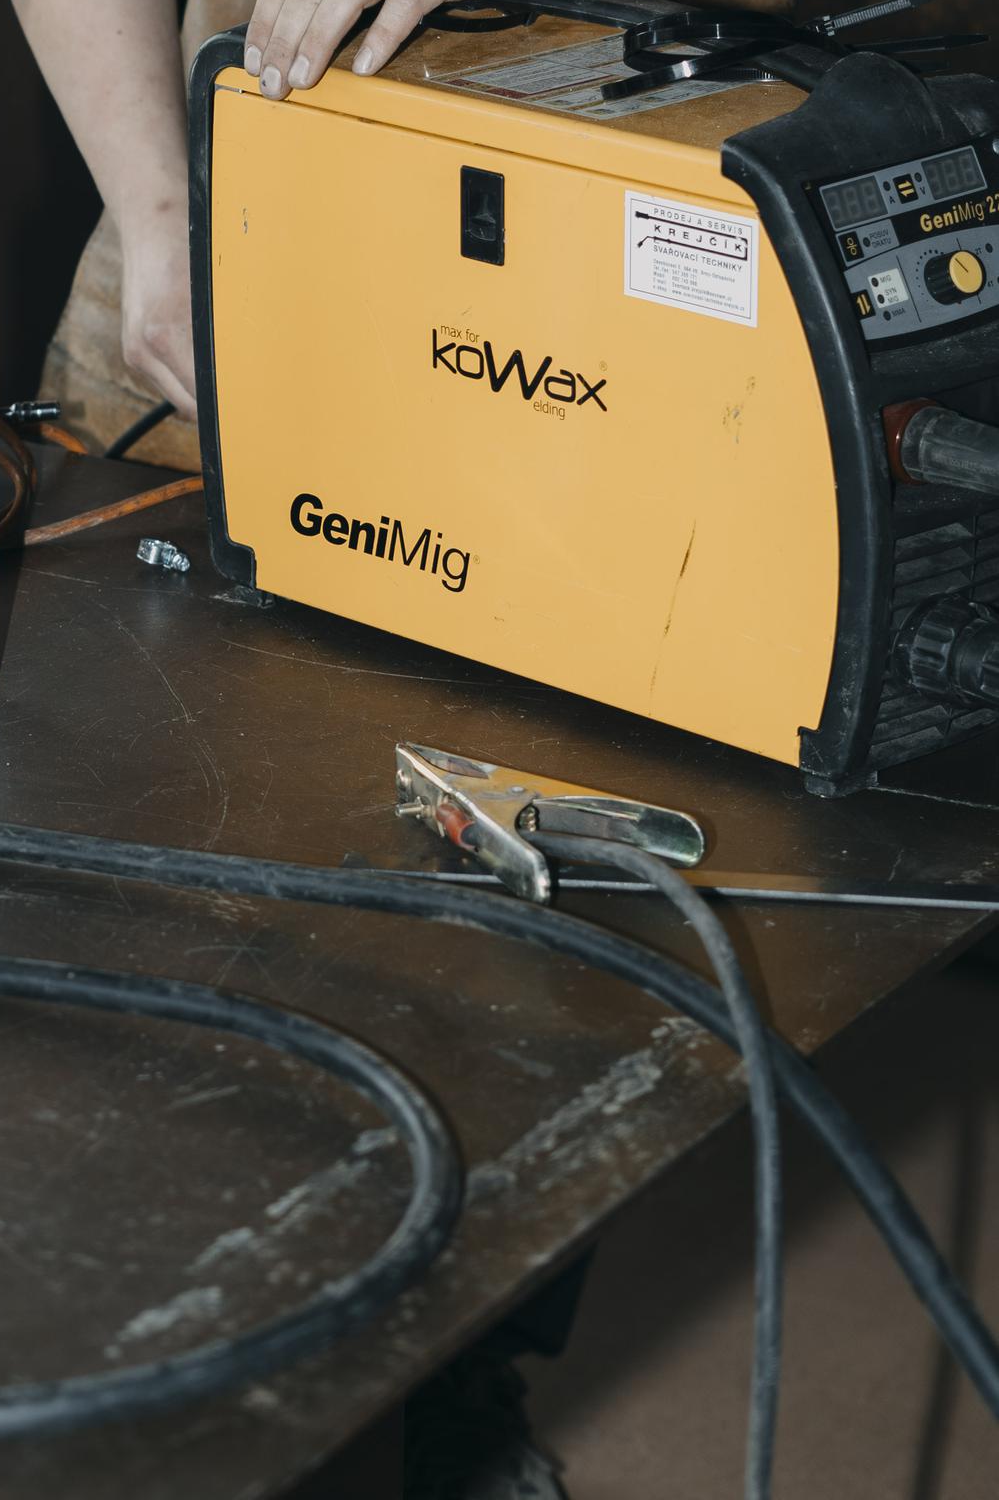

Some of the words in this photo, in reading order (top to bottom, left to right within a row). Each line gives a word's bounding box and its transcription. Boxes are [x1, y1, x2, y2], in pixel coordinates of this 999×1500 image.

[653, 208, 692, 223] PRODEJ
[707, 220, 743, 235] SERVIS
[920, 201, 984, 233] GeniMig
[702, 256, 742, 272] TECHNIKY
[440, 325, 462, 339] max
[465, 328, 480, 343] for
[533, 400, 566, 420] elding
[290, 493, 471, 593] GeniMig
